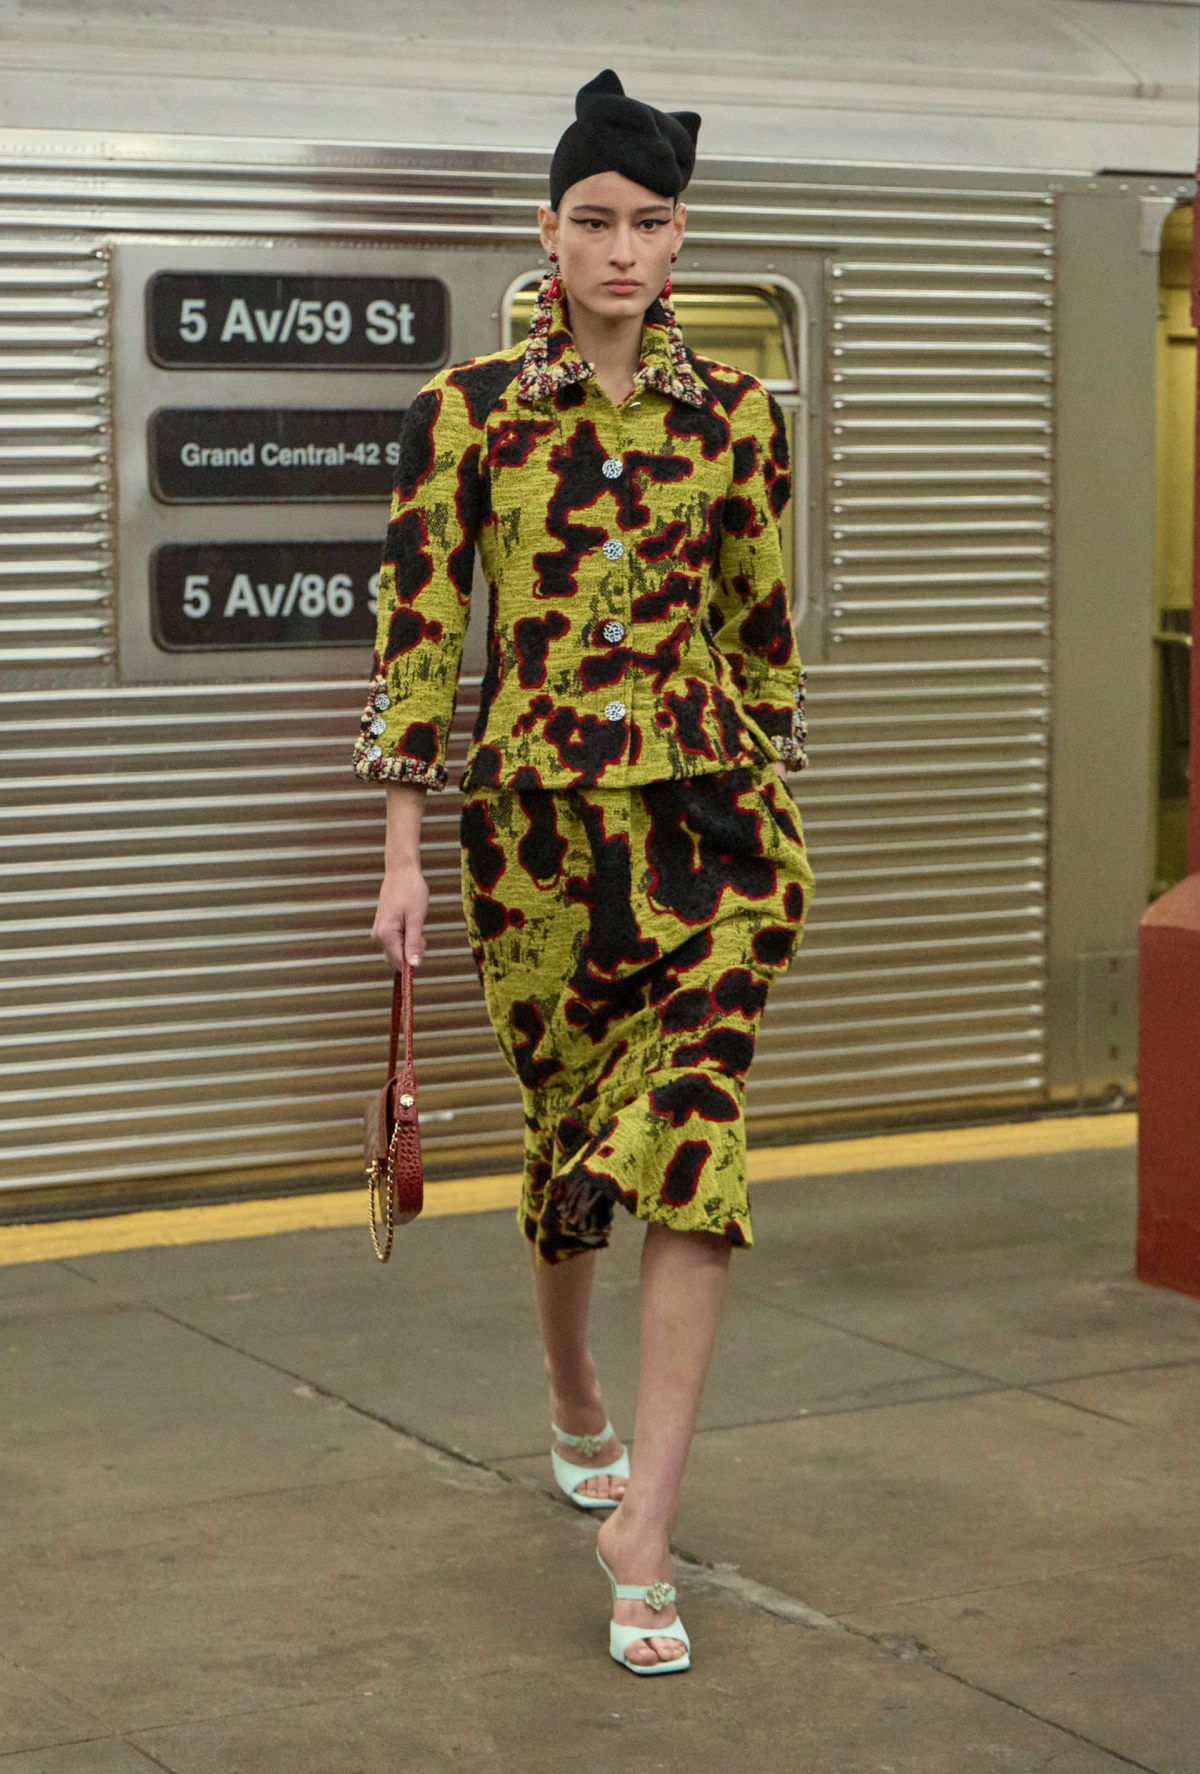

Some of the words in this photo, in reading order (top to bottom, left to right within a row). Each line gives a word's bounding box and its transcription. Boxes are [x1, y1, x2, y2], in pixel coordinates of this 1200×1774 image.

[179, 298, 207, 342] 5
[220, 298, 351, 343] Av/59
[365, 300, 415, 344] St
[180, 442, 254, 466] Grand
[260, 441, 380, 466] Central-42
[182, 575, 211, 618] 5
[223, 573, 354, 618] Av/86
